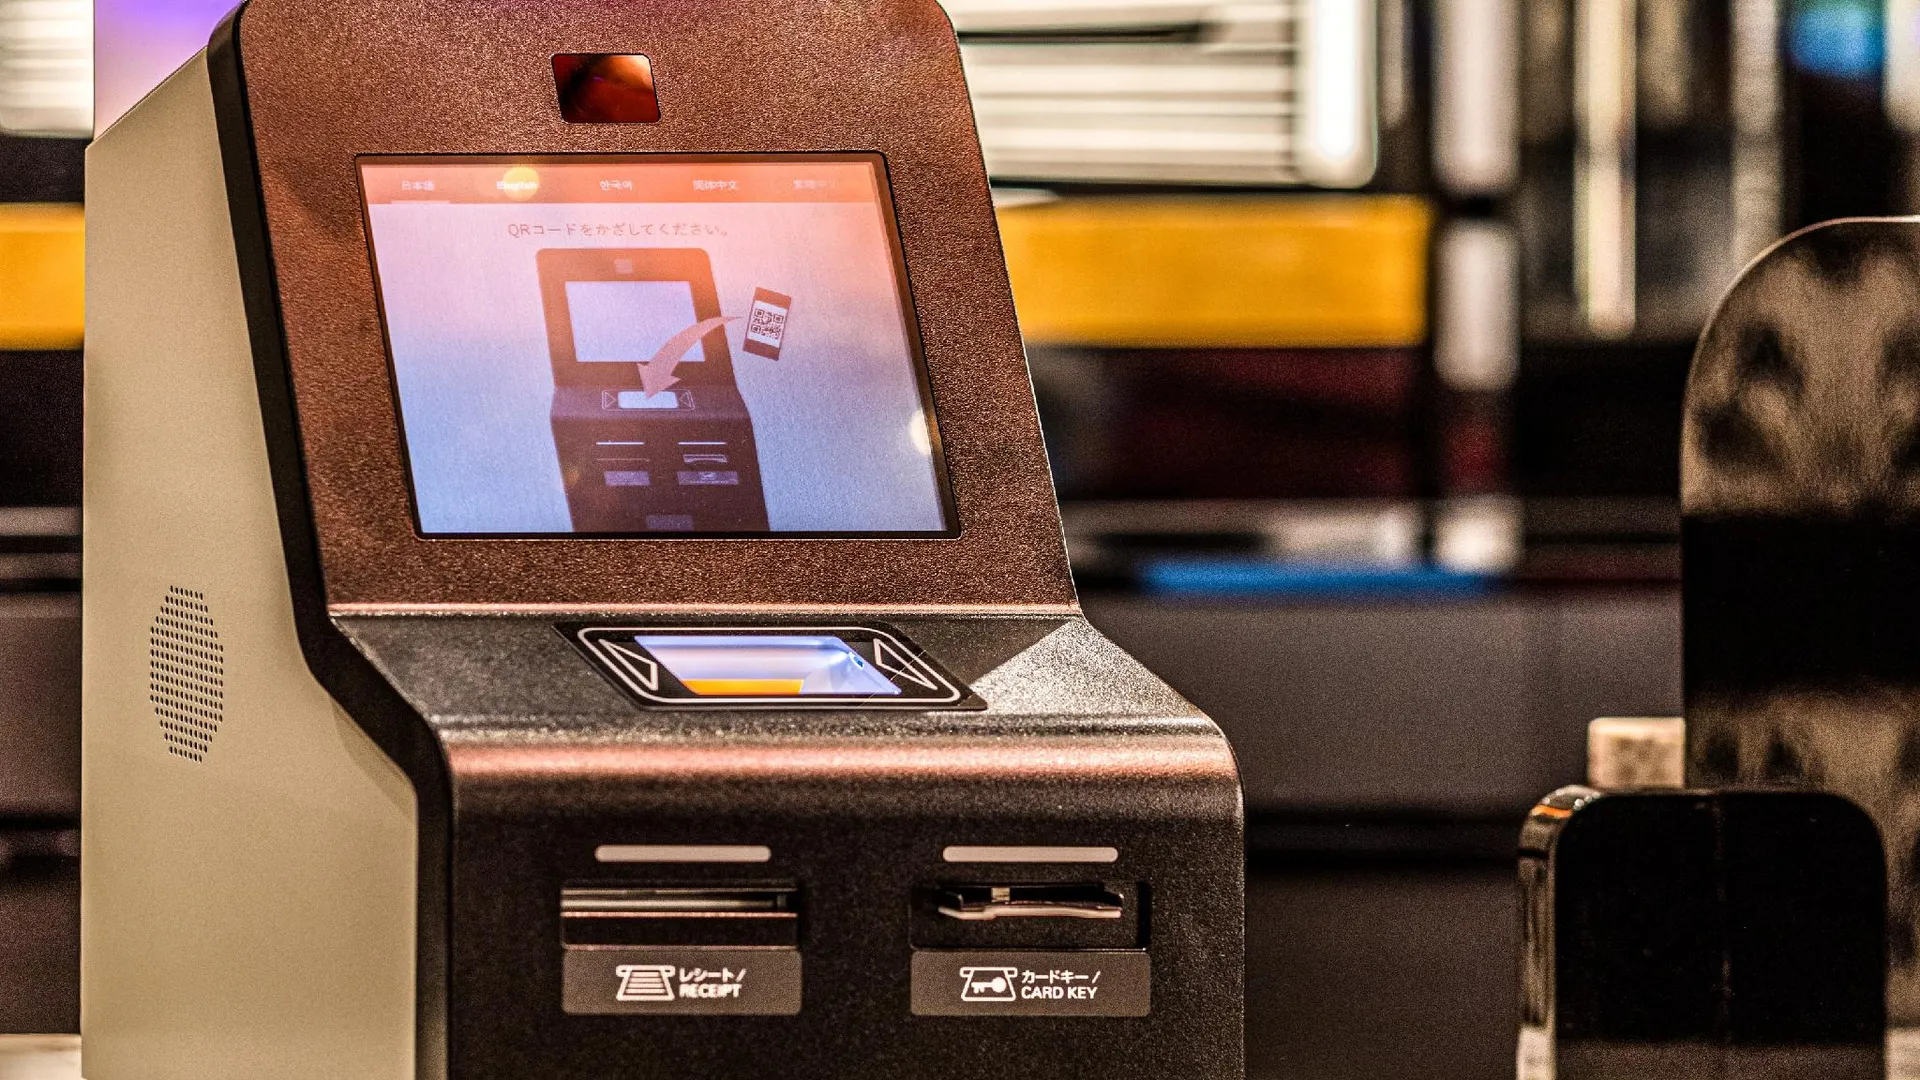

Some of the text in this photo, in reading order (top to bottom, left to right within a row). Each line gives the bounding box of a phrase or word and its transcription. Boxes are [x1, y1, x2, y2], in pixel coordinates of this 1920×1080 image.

[402, 180, 435, 191] 日本語
[600, 179, 633, 191] 한국어
[507, 222, 729, 237] QRコードをかざしてください。
[678, 983, 743, 998] RECEIPT
[1021, 986, 1098, 1000] CARD KEY
